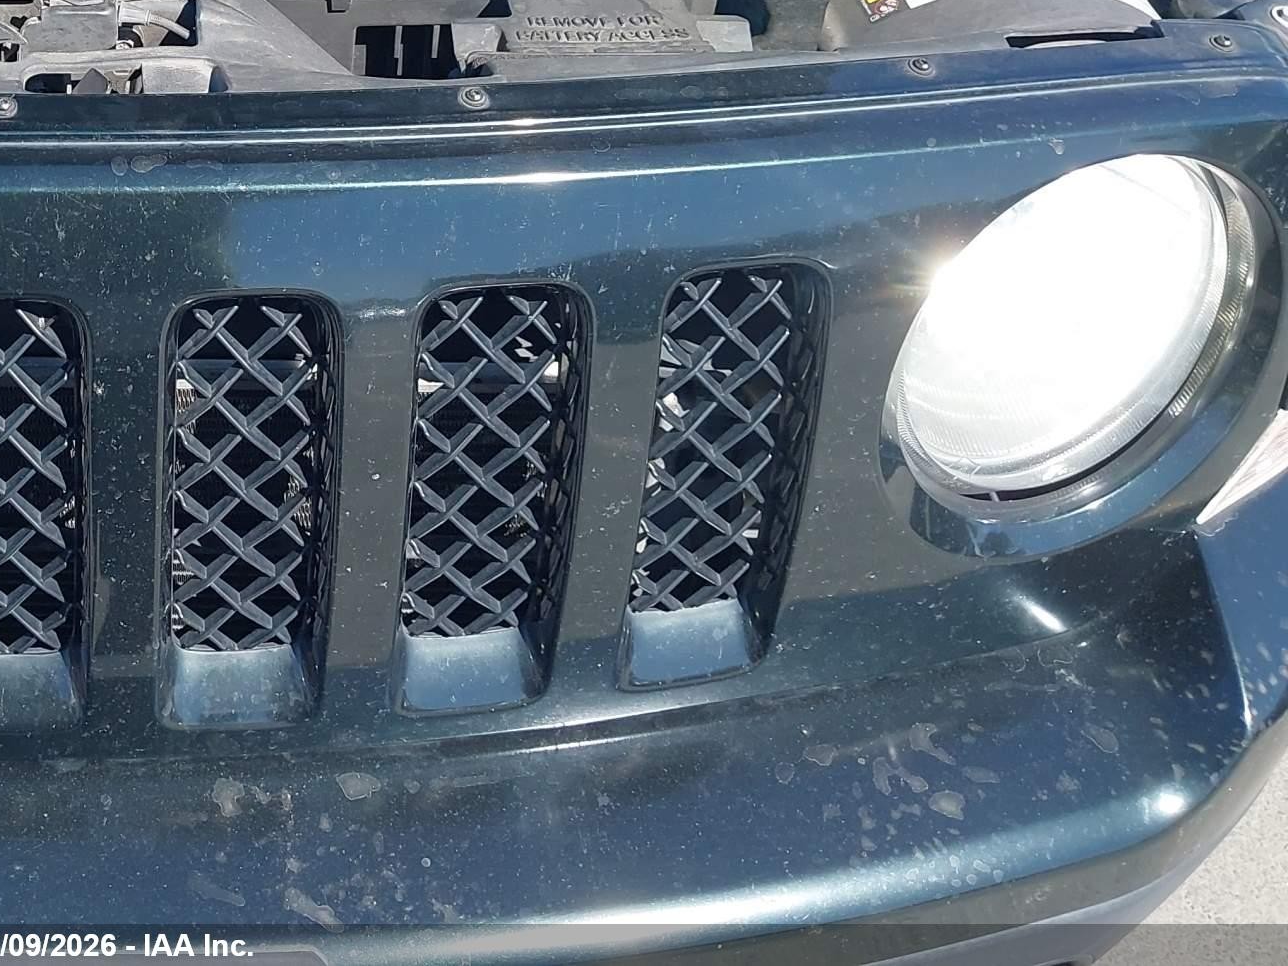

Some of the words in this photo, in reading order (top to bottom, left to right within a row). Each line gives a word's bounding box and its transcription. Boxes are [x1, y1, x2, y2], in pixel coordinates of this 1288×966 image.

[526, 15, 610, 28] REMOVE
[617, 15, 662, 27] FOR
[515, 29, 601, 42] BATTERY
[608, 27, 690, 42] ACCESS
